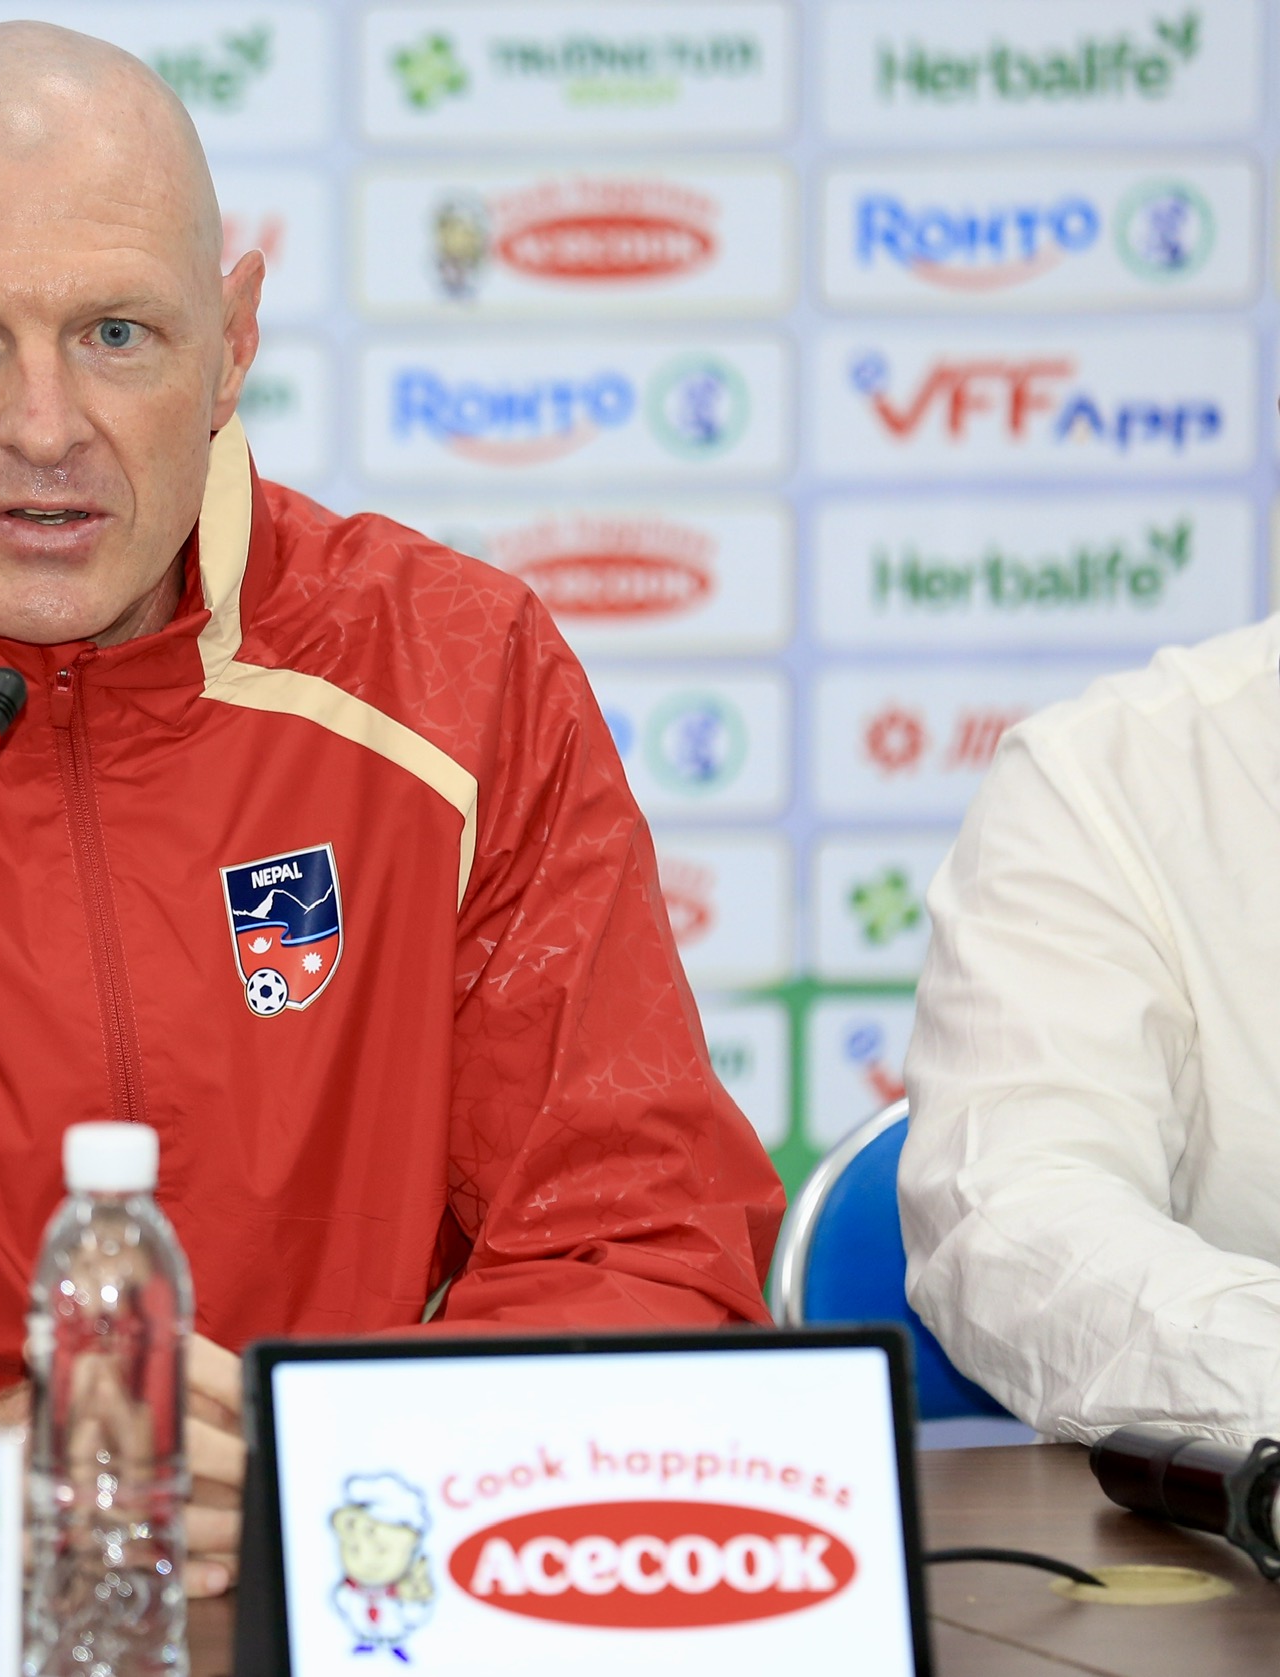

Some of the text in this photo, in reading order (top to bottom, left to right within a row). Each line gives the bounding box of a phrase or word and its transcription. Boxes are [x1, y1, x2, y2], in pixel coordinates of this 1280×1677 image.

[876, 38, 1172, 100] Herbalife
[874, 354, 1223, 455] VFF App
[872, 545, 1166, 608] Herbalife
[251, 862, 303, 889] NEPAL
[441, 1440, 854, 1510] Cook happiness
